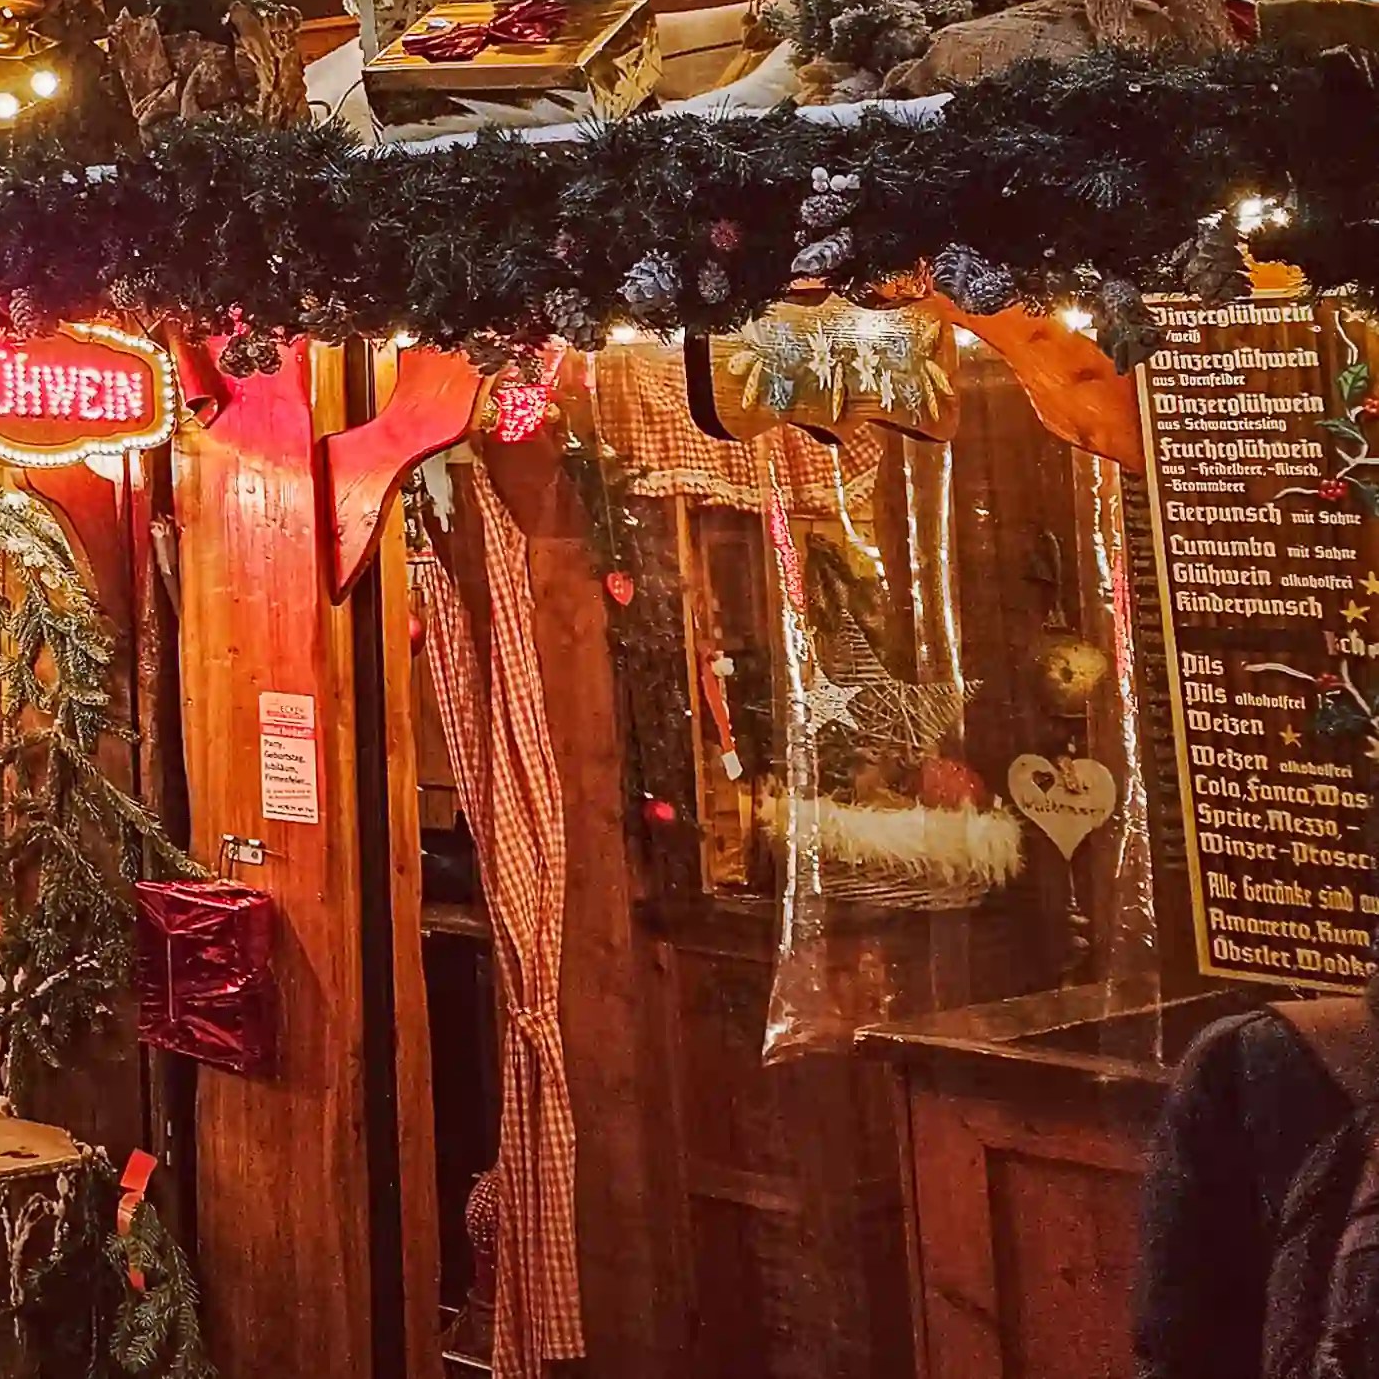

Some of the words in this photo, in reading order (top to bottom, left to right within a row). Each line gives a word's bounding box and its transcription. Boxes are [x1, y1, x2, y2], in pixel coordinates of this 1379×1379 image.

[1149, 347, 1320, 372] Winzerglühwein
[1152, 375, 1175, 387] aus
[1178, 372, 1246, 388] Dornfelder
[1152, 392, 1325, 416] Winzerglühwein
[1157, 419, 1181, 431] aus
[1159, 437, 1324, 461] Fruchtglühwein
[1162, 464, 1185, 475] aus
[1166, 501, 1282, 526] Eierpunsch
[1290, 509, 1315, 524] mit
[1318, 510, 1362, 526] Sahne
[1169, 534, 1277, 557] Lumumba
[1286, 544, 1310, 559] mit
[1314, 545, 1357, 561] Sahne
[1173, 561, 1272, 586] Glühwein
[1280, 574, 1354, 591] alkoholfrei
[1175, 590, 1323, 619] Kinderpunsch
[1181, 650, 1224, 678] Pils
[1184, 681, 1228, 705] Pils
[1234, 692, 1307, 710] alkoholfrei
[1186, 709, 1266, 736] Weizen
[1190, 744, 1269, 771] Weizen
[1279, 759, 1353, 779] alkoholfrei
[1206, 871, 1238, 901] Alle
[1242, 874, 1313, 909] Getränke
[1318, 884, 1355, 912] sind
